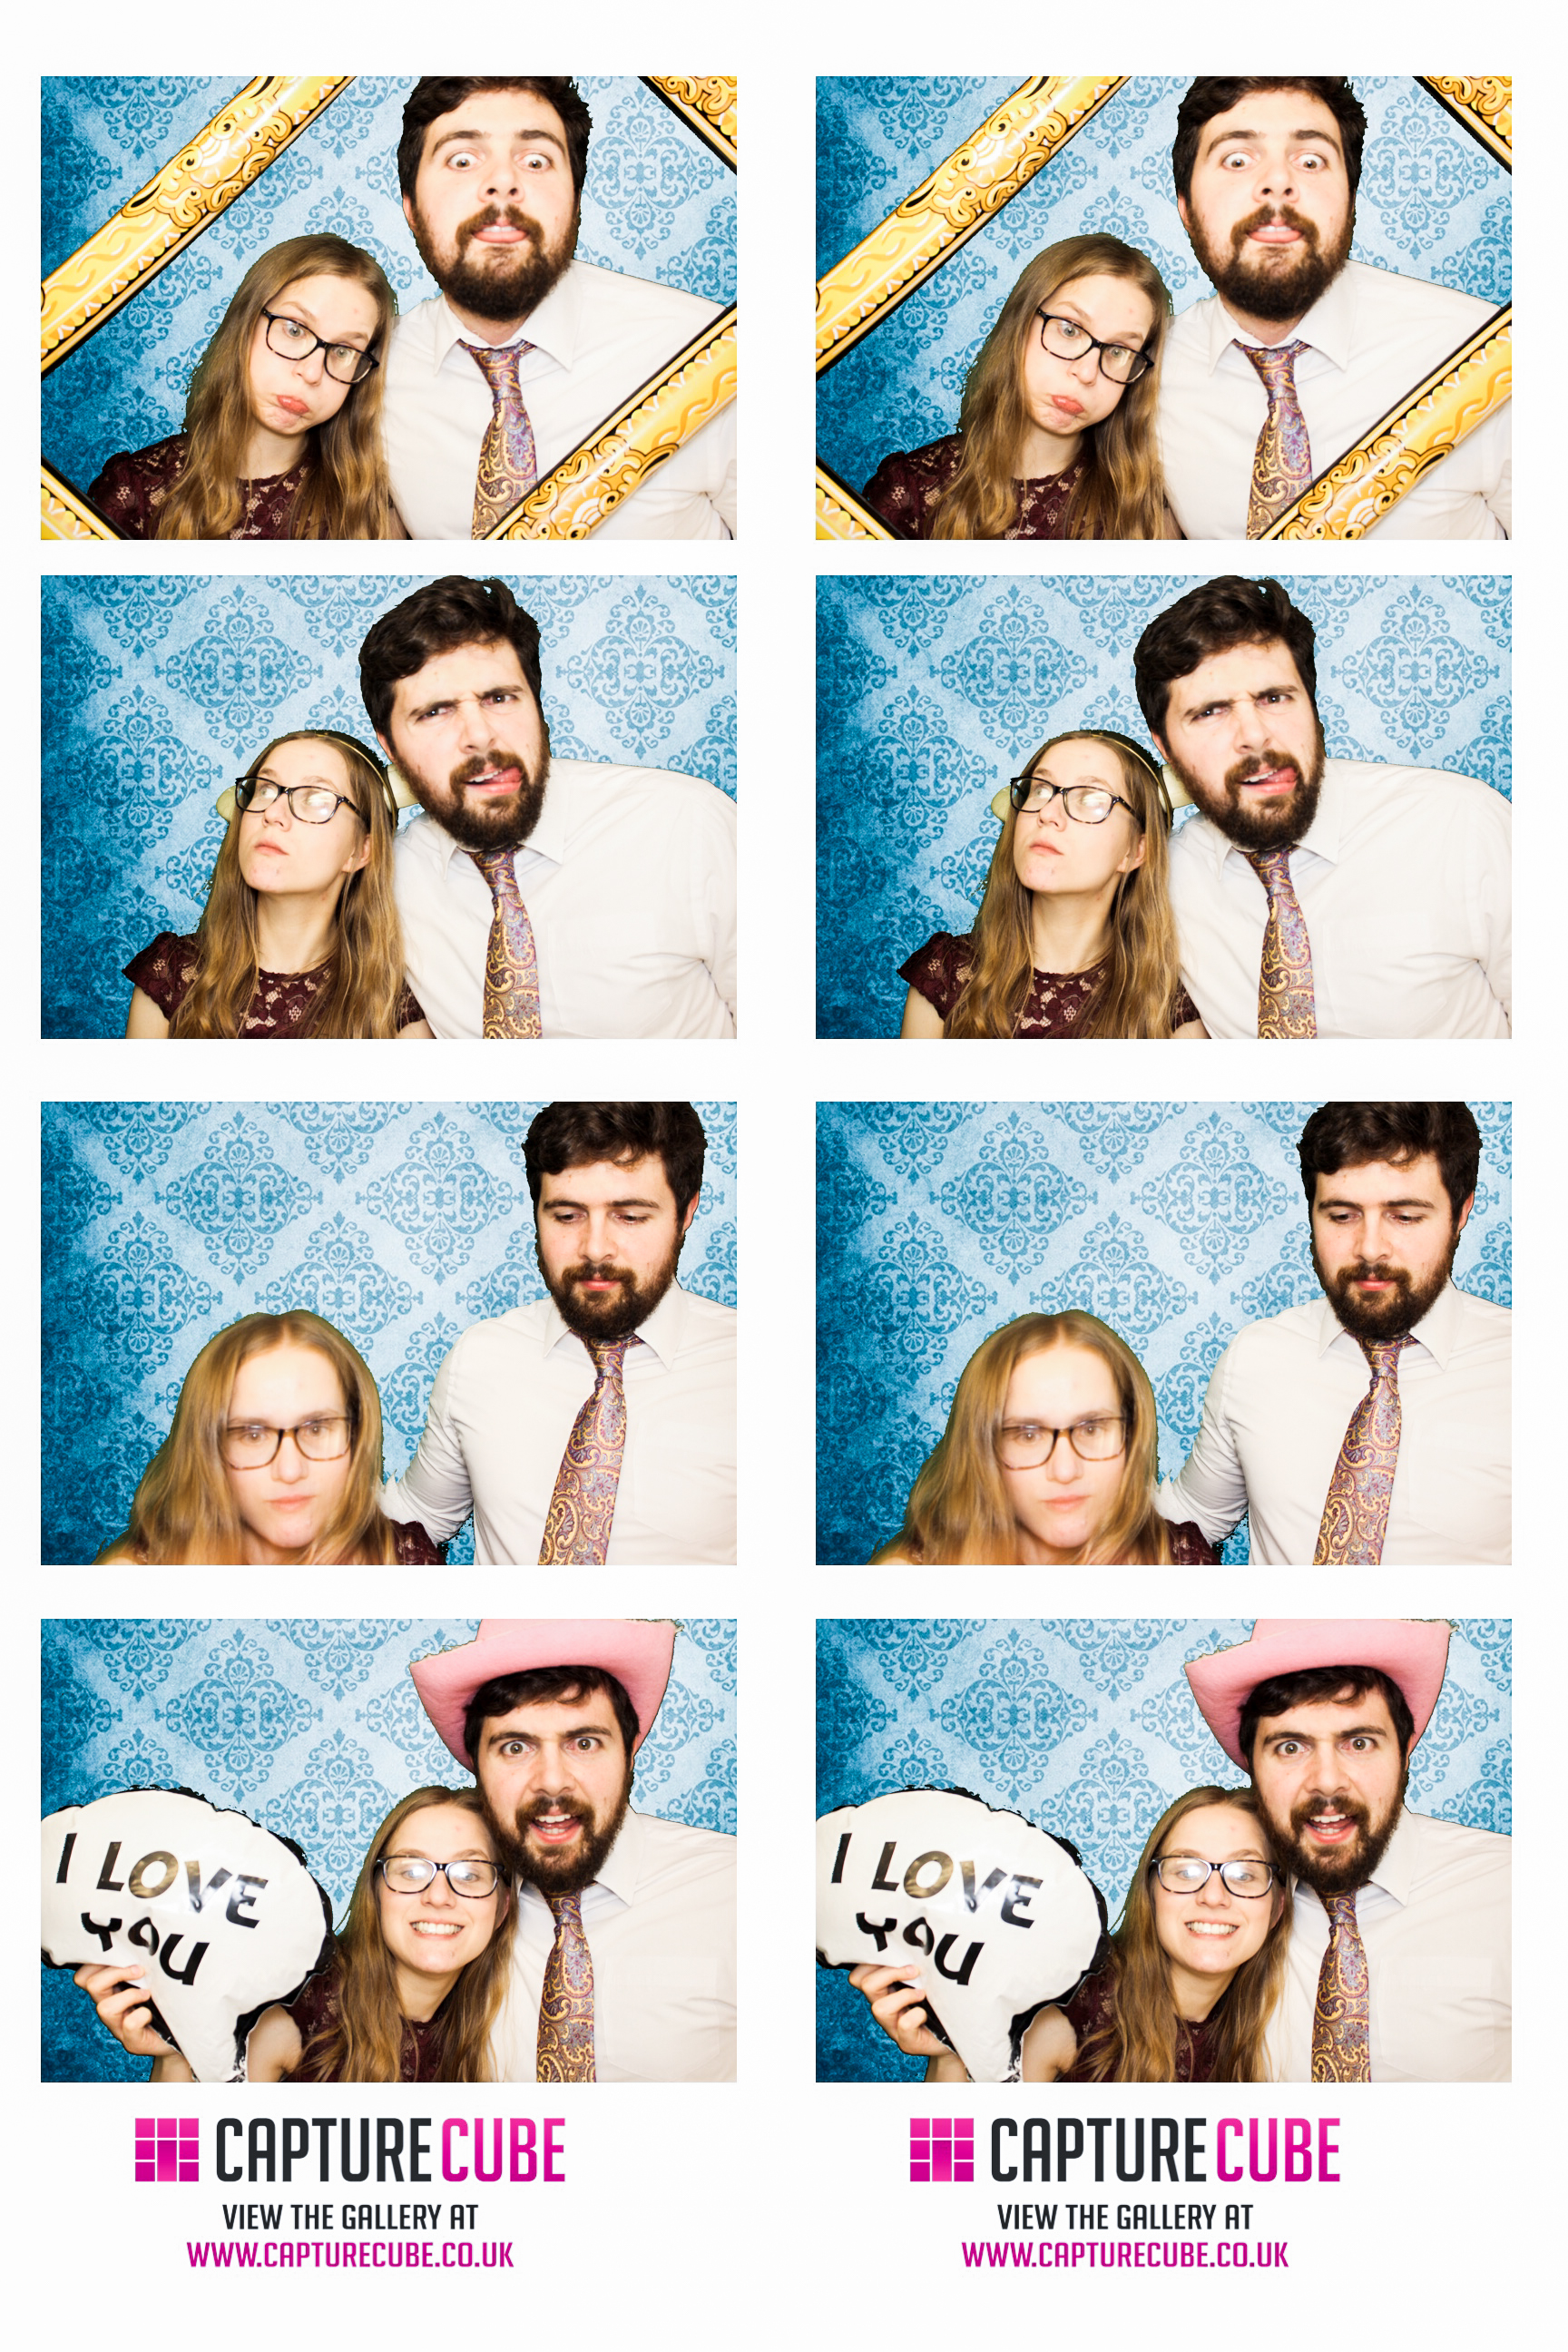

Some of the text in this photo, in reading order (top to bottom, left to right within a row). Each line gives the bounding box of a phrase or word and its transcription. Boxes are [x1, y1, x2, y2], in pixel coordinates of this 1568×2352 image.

[56, 1832, 269, 1928] I LOVE
[831, 1832, 1044, 1928] I LOVE
[81, 1912, 210, 1985] YOU
[856, 1912, 985, 1985] YOU
